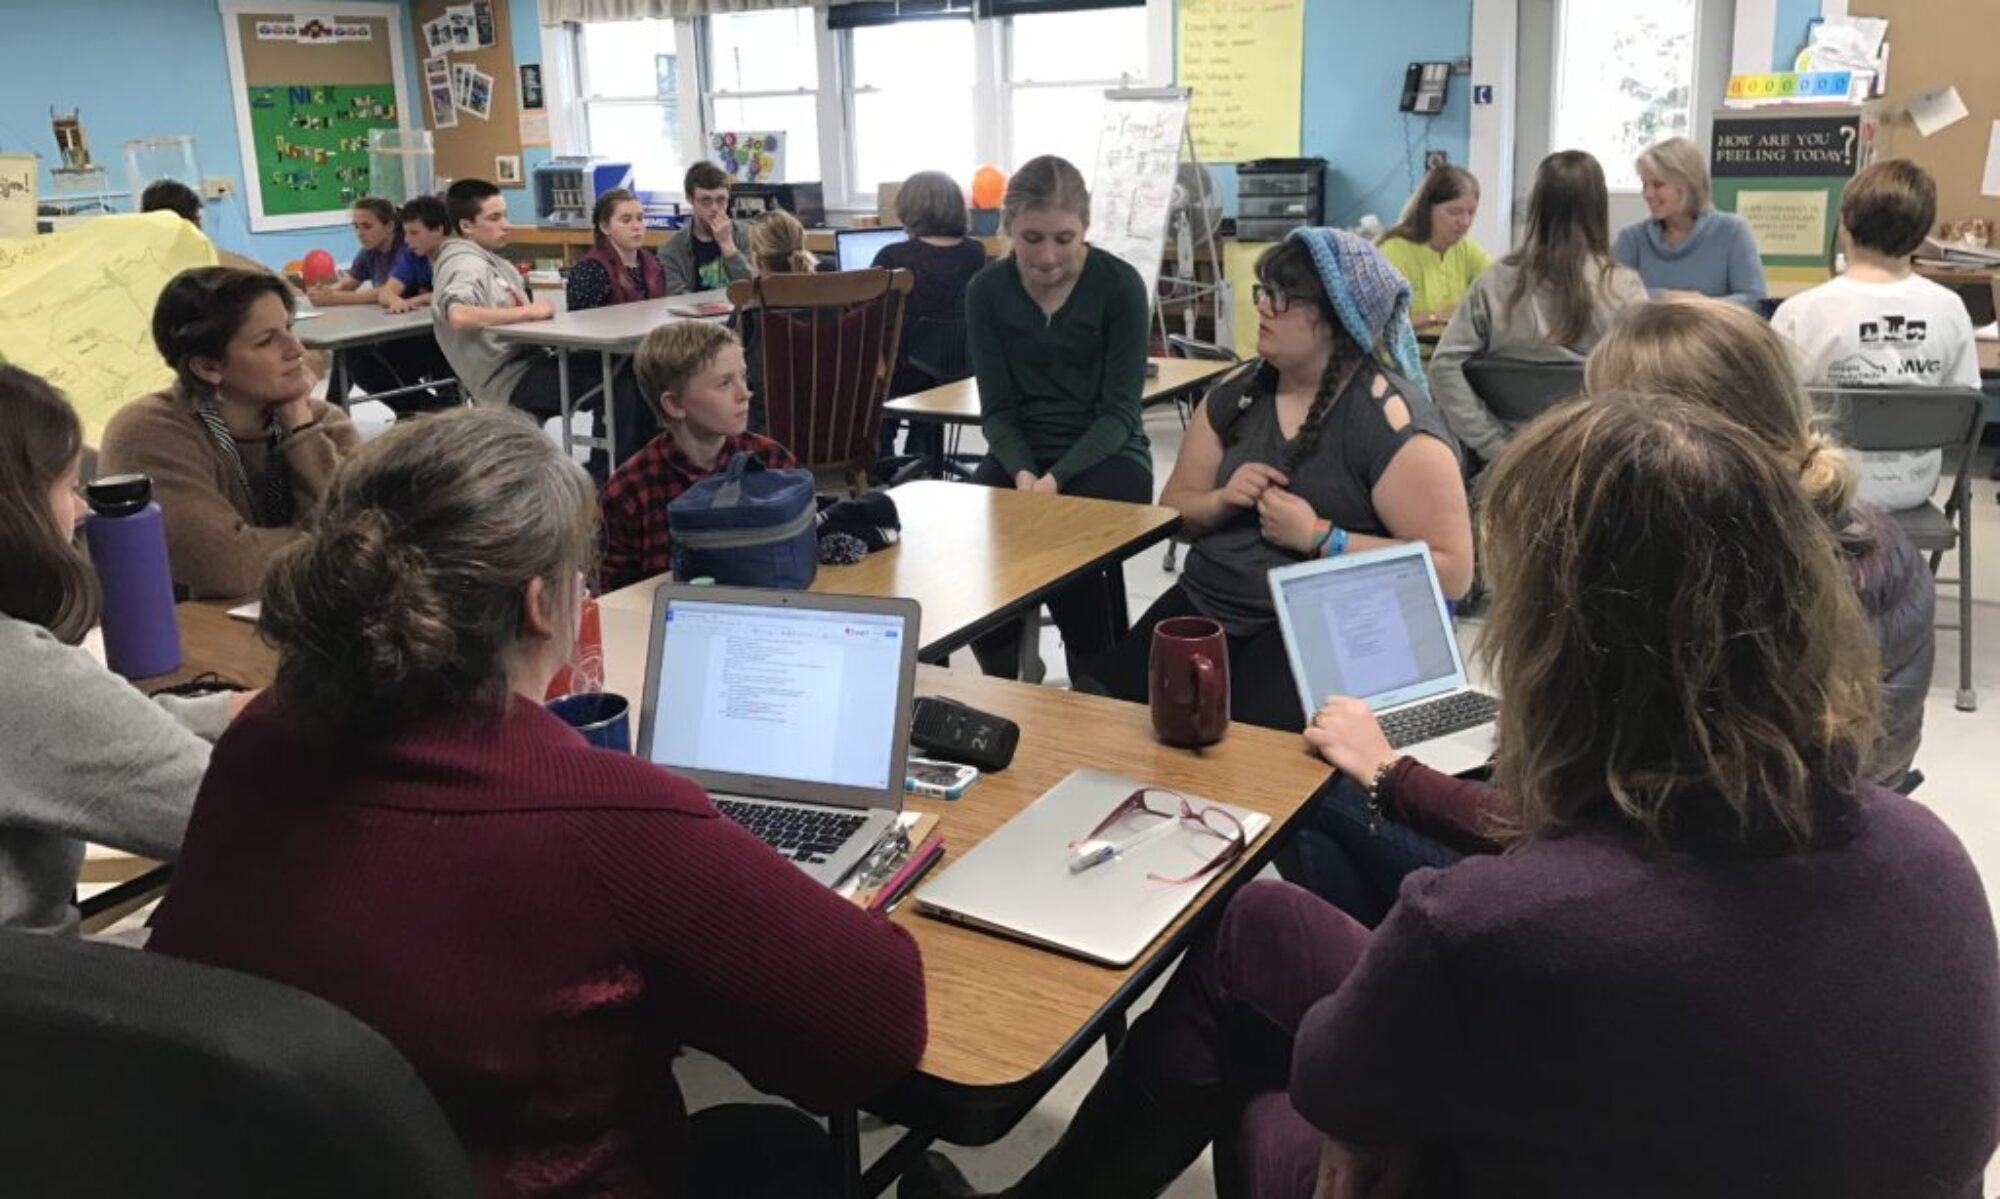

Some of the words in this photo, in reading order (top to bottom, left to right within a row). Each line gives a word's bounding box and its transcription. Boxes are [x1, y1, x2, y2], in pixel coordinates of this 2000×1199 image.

[1718, 134, 1752, 147] HOW
[1757, 133, 1790, 146] ARE
[1795, 132, 1830, 146] YOU
[1716, 149, 1786, 163] FEELING
